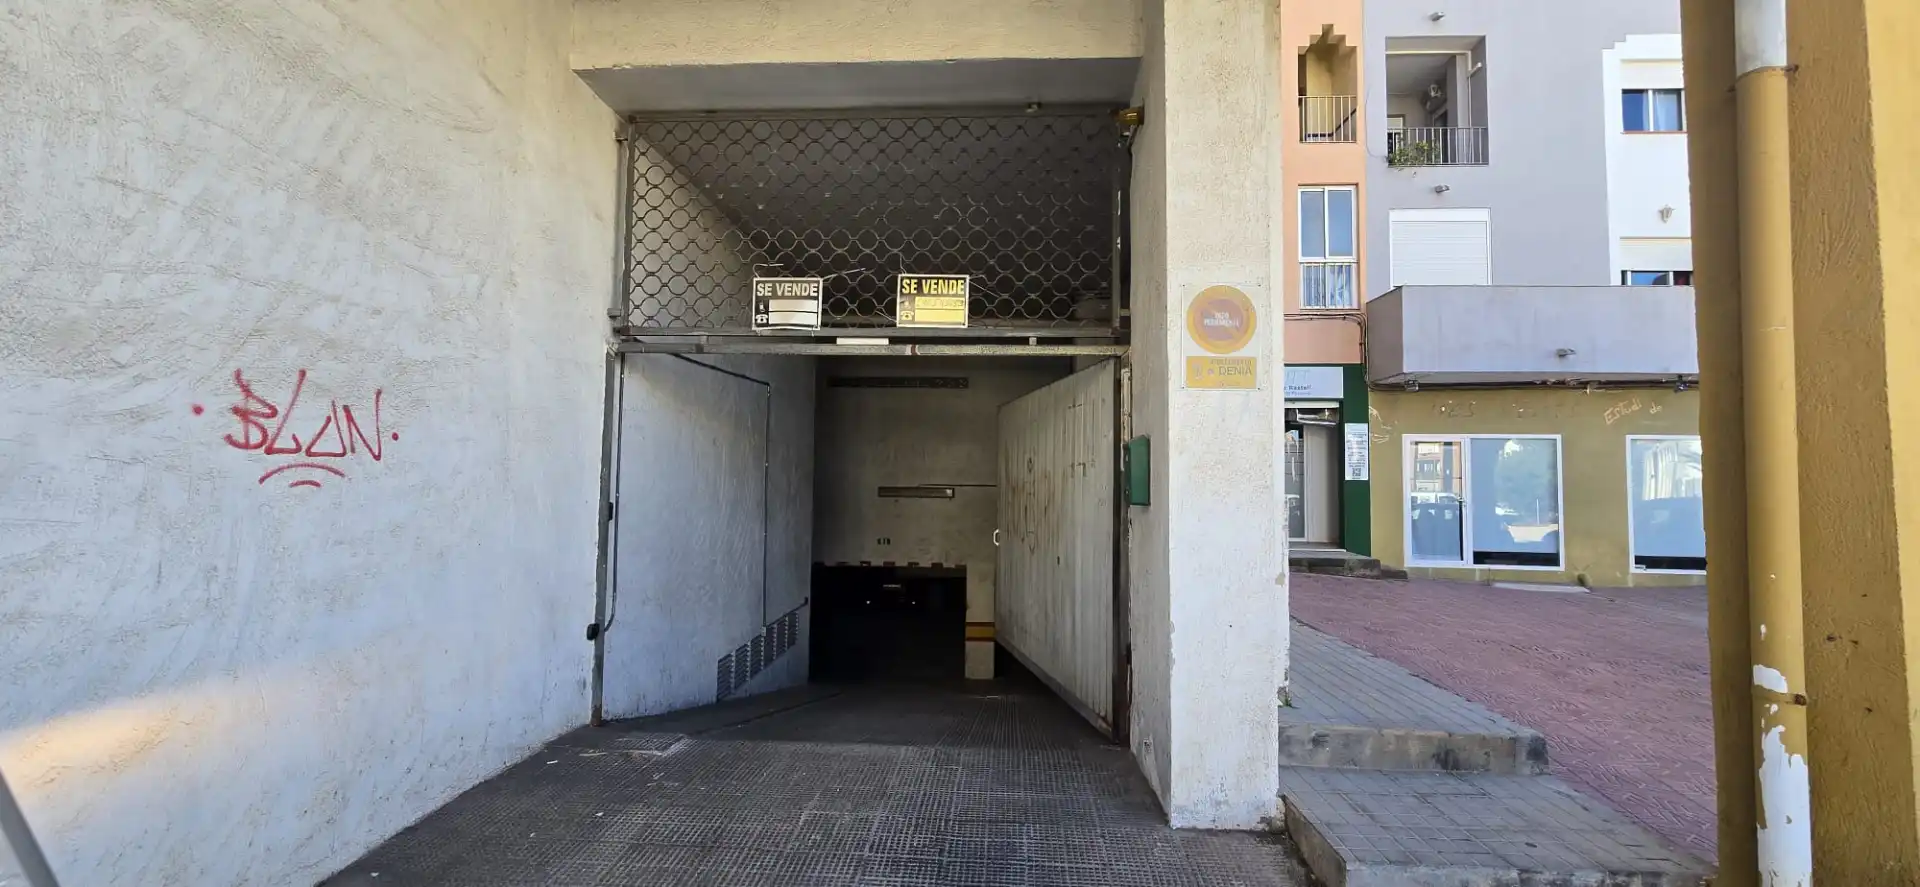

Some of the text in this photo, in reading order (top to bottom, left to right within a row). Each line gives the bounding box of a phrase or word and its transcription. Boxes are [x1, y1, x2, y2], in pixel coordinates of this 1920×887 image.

[756, 283, 819, 297] SE VENDE
[902, 279, 965, 295] SE VENDE
